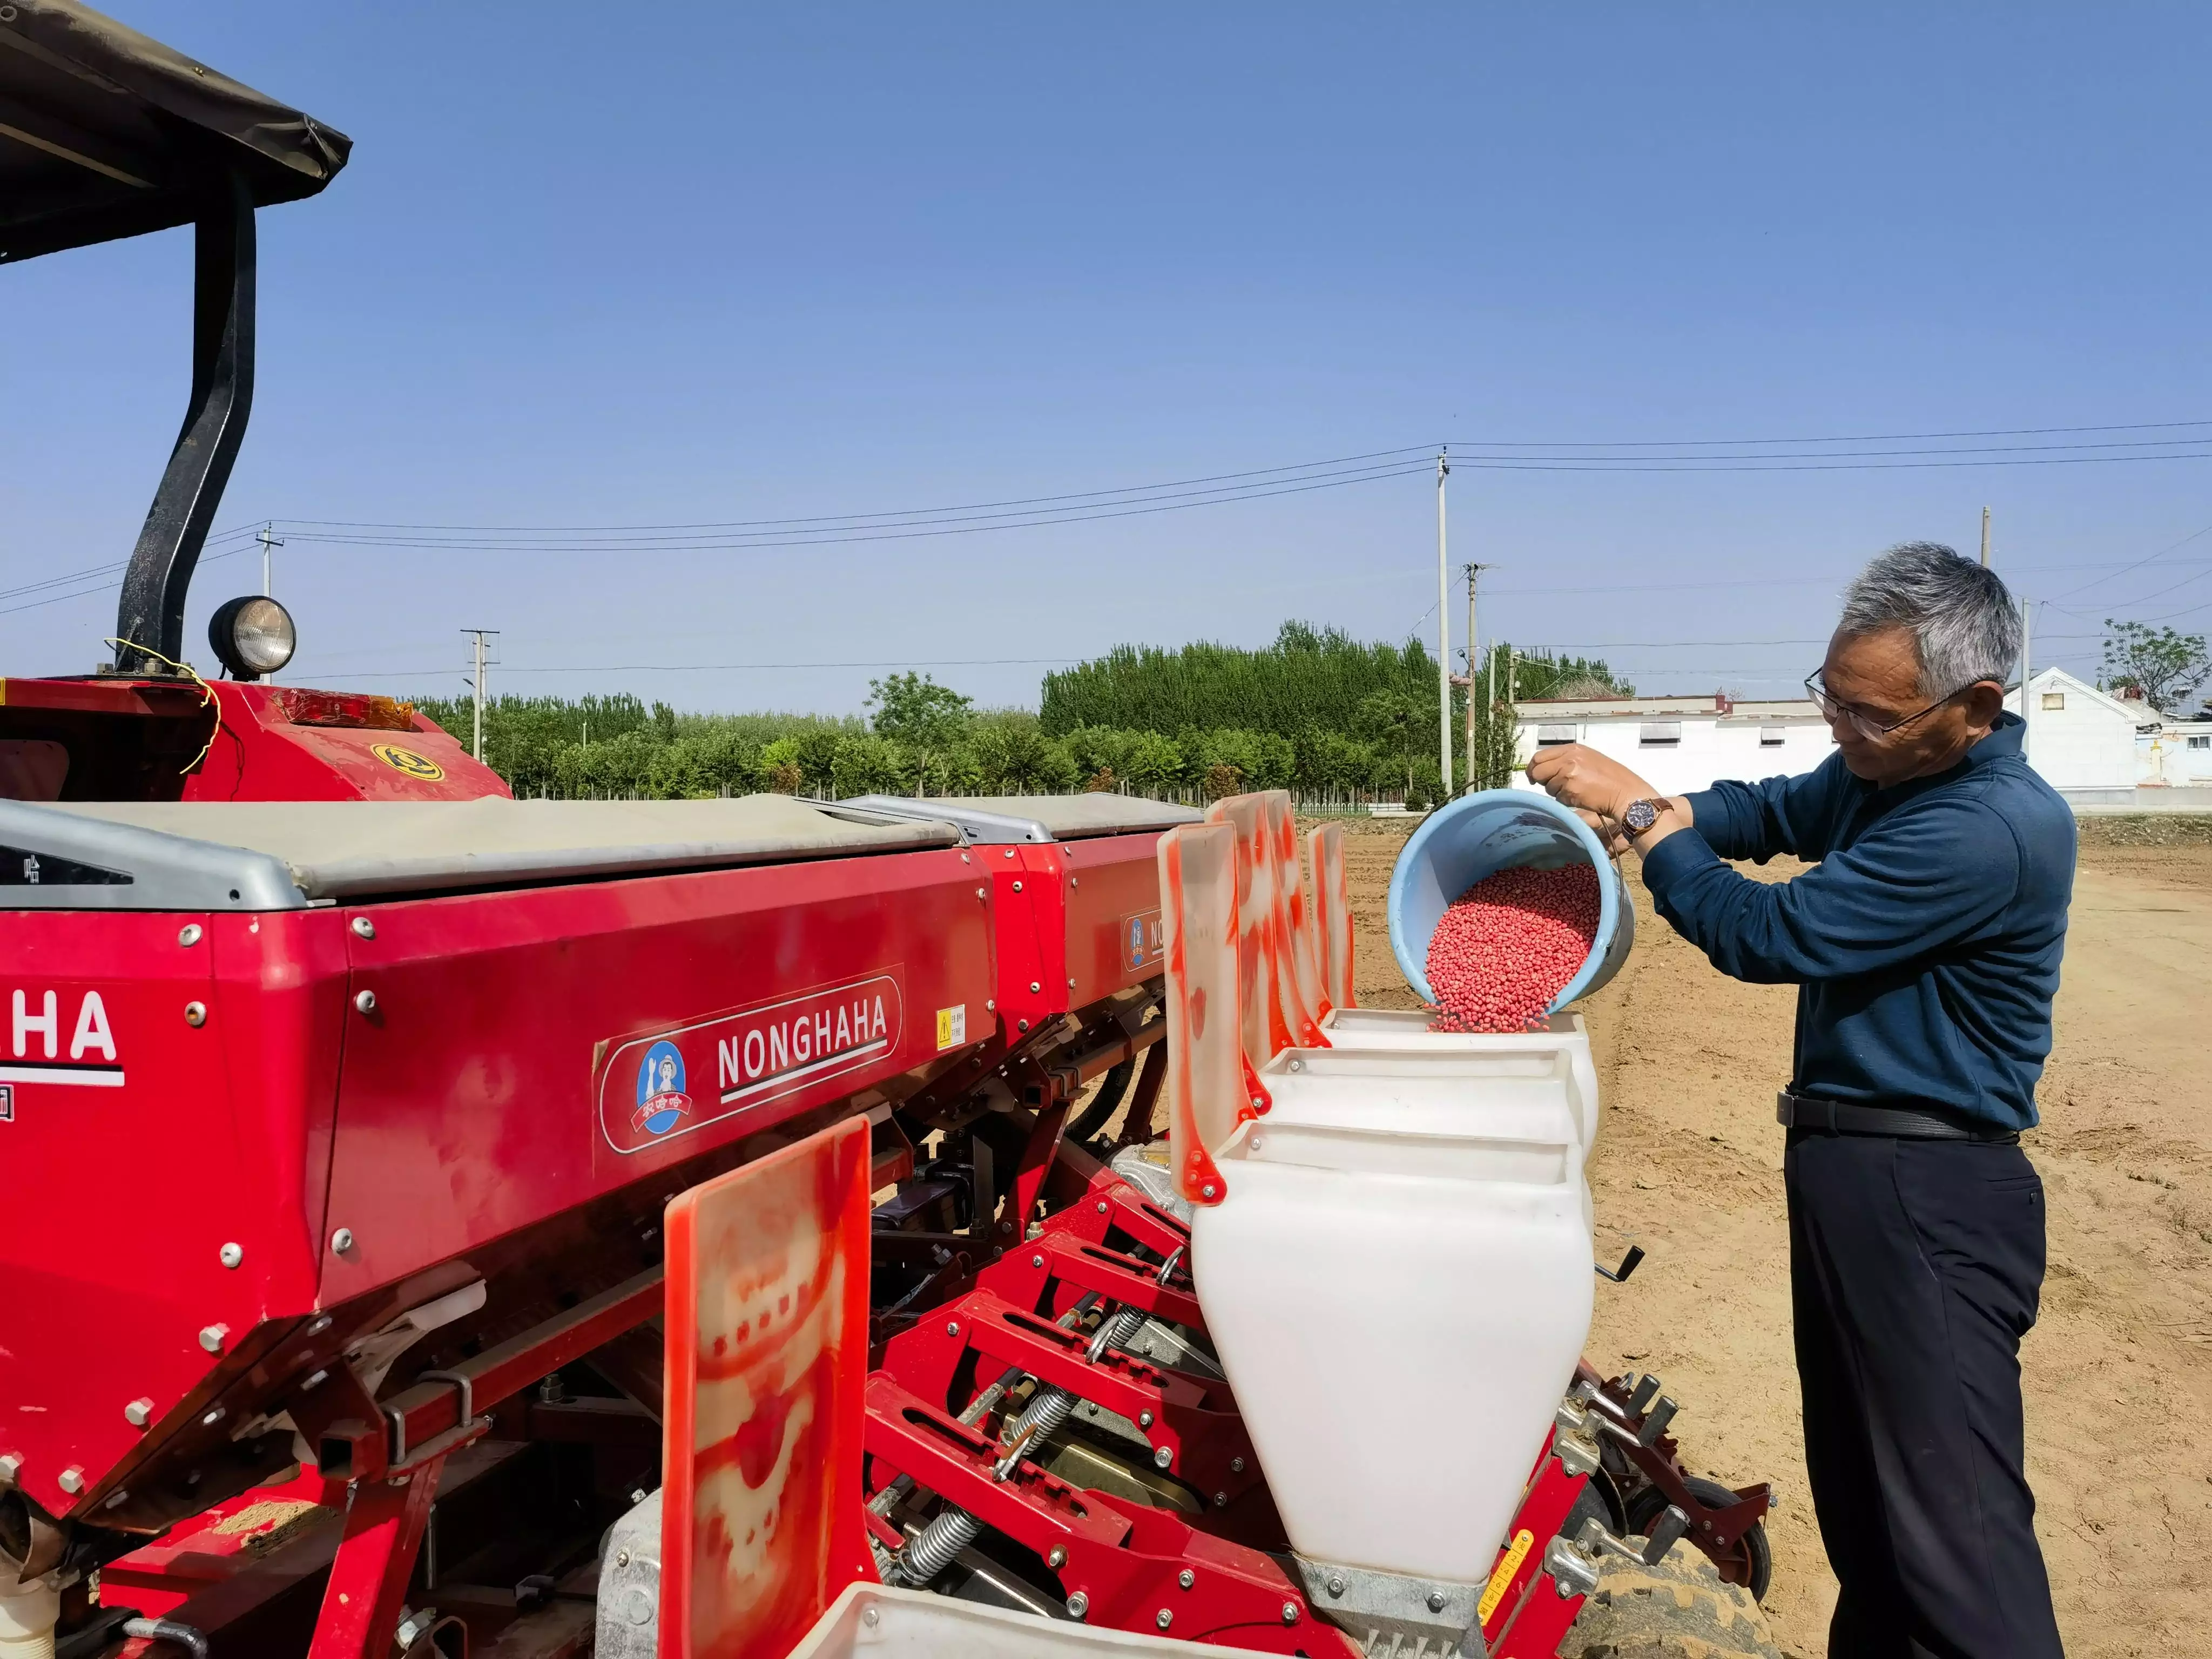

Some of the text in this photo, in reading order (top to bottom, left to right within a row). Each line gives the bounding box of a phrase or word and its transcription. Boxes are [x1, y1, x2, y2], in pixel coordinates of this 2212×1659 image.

[24, 854, 40, 884] 哈
[719, 995, 887, 1089] NONGHAHA
[642, 1094, 683, 1118] 农哈哈
